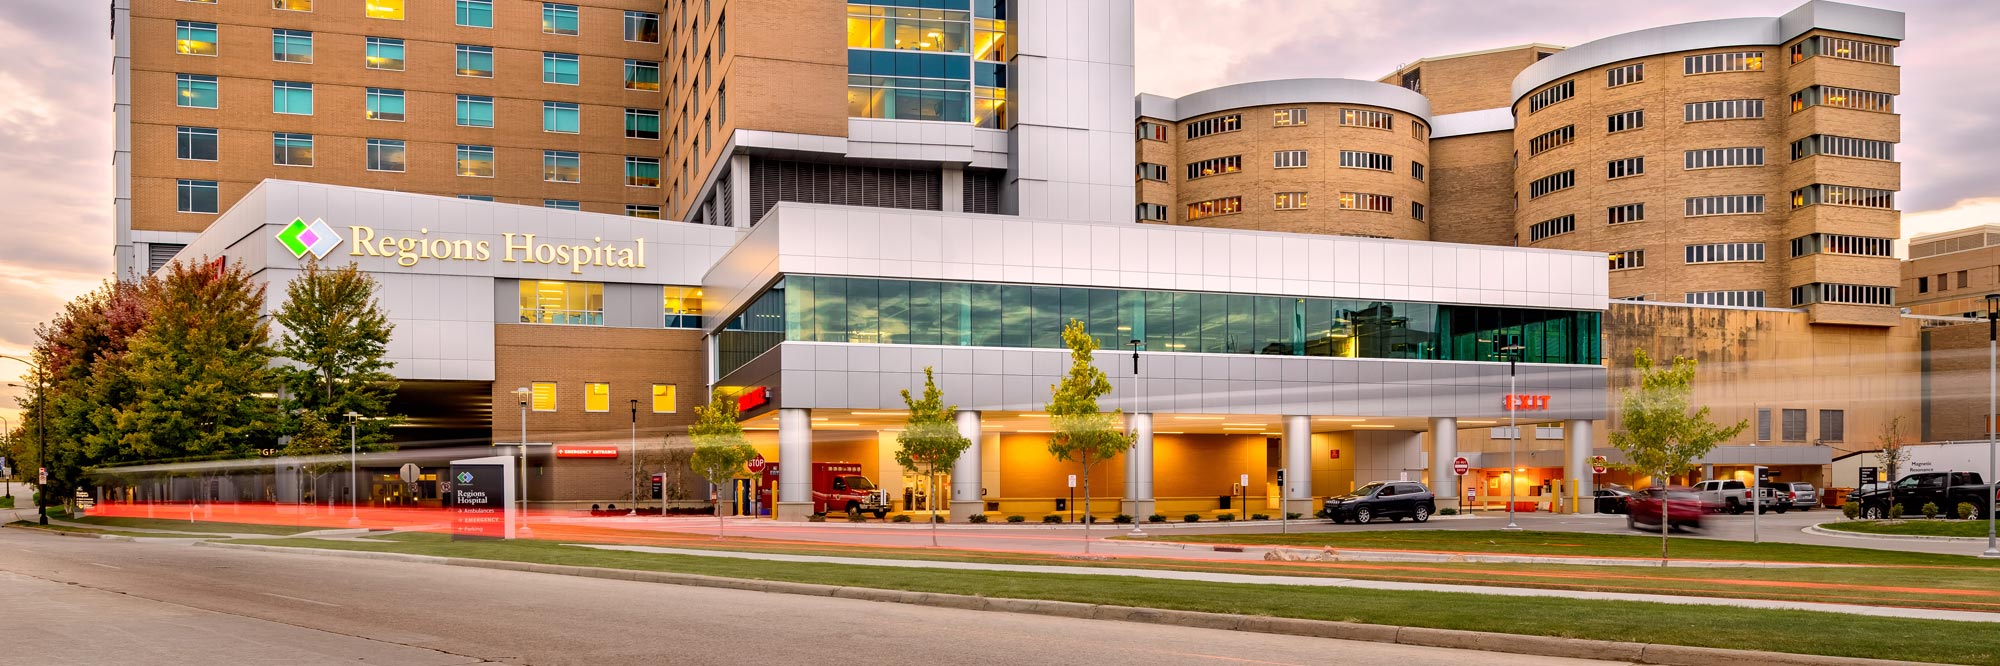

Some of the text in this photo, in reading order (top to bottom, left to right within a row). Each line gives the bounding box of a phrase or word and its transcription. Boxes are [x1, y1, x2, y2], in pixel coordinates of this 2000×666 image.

[349, 225, 646, 274] Regions Hospital
[1505, 394, 1551, 411] EXIT
[748, 459, 764, 467] STOP
[457, 489, 486, 498] Regions
[457, 496, 488, 505] Hospital
